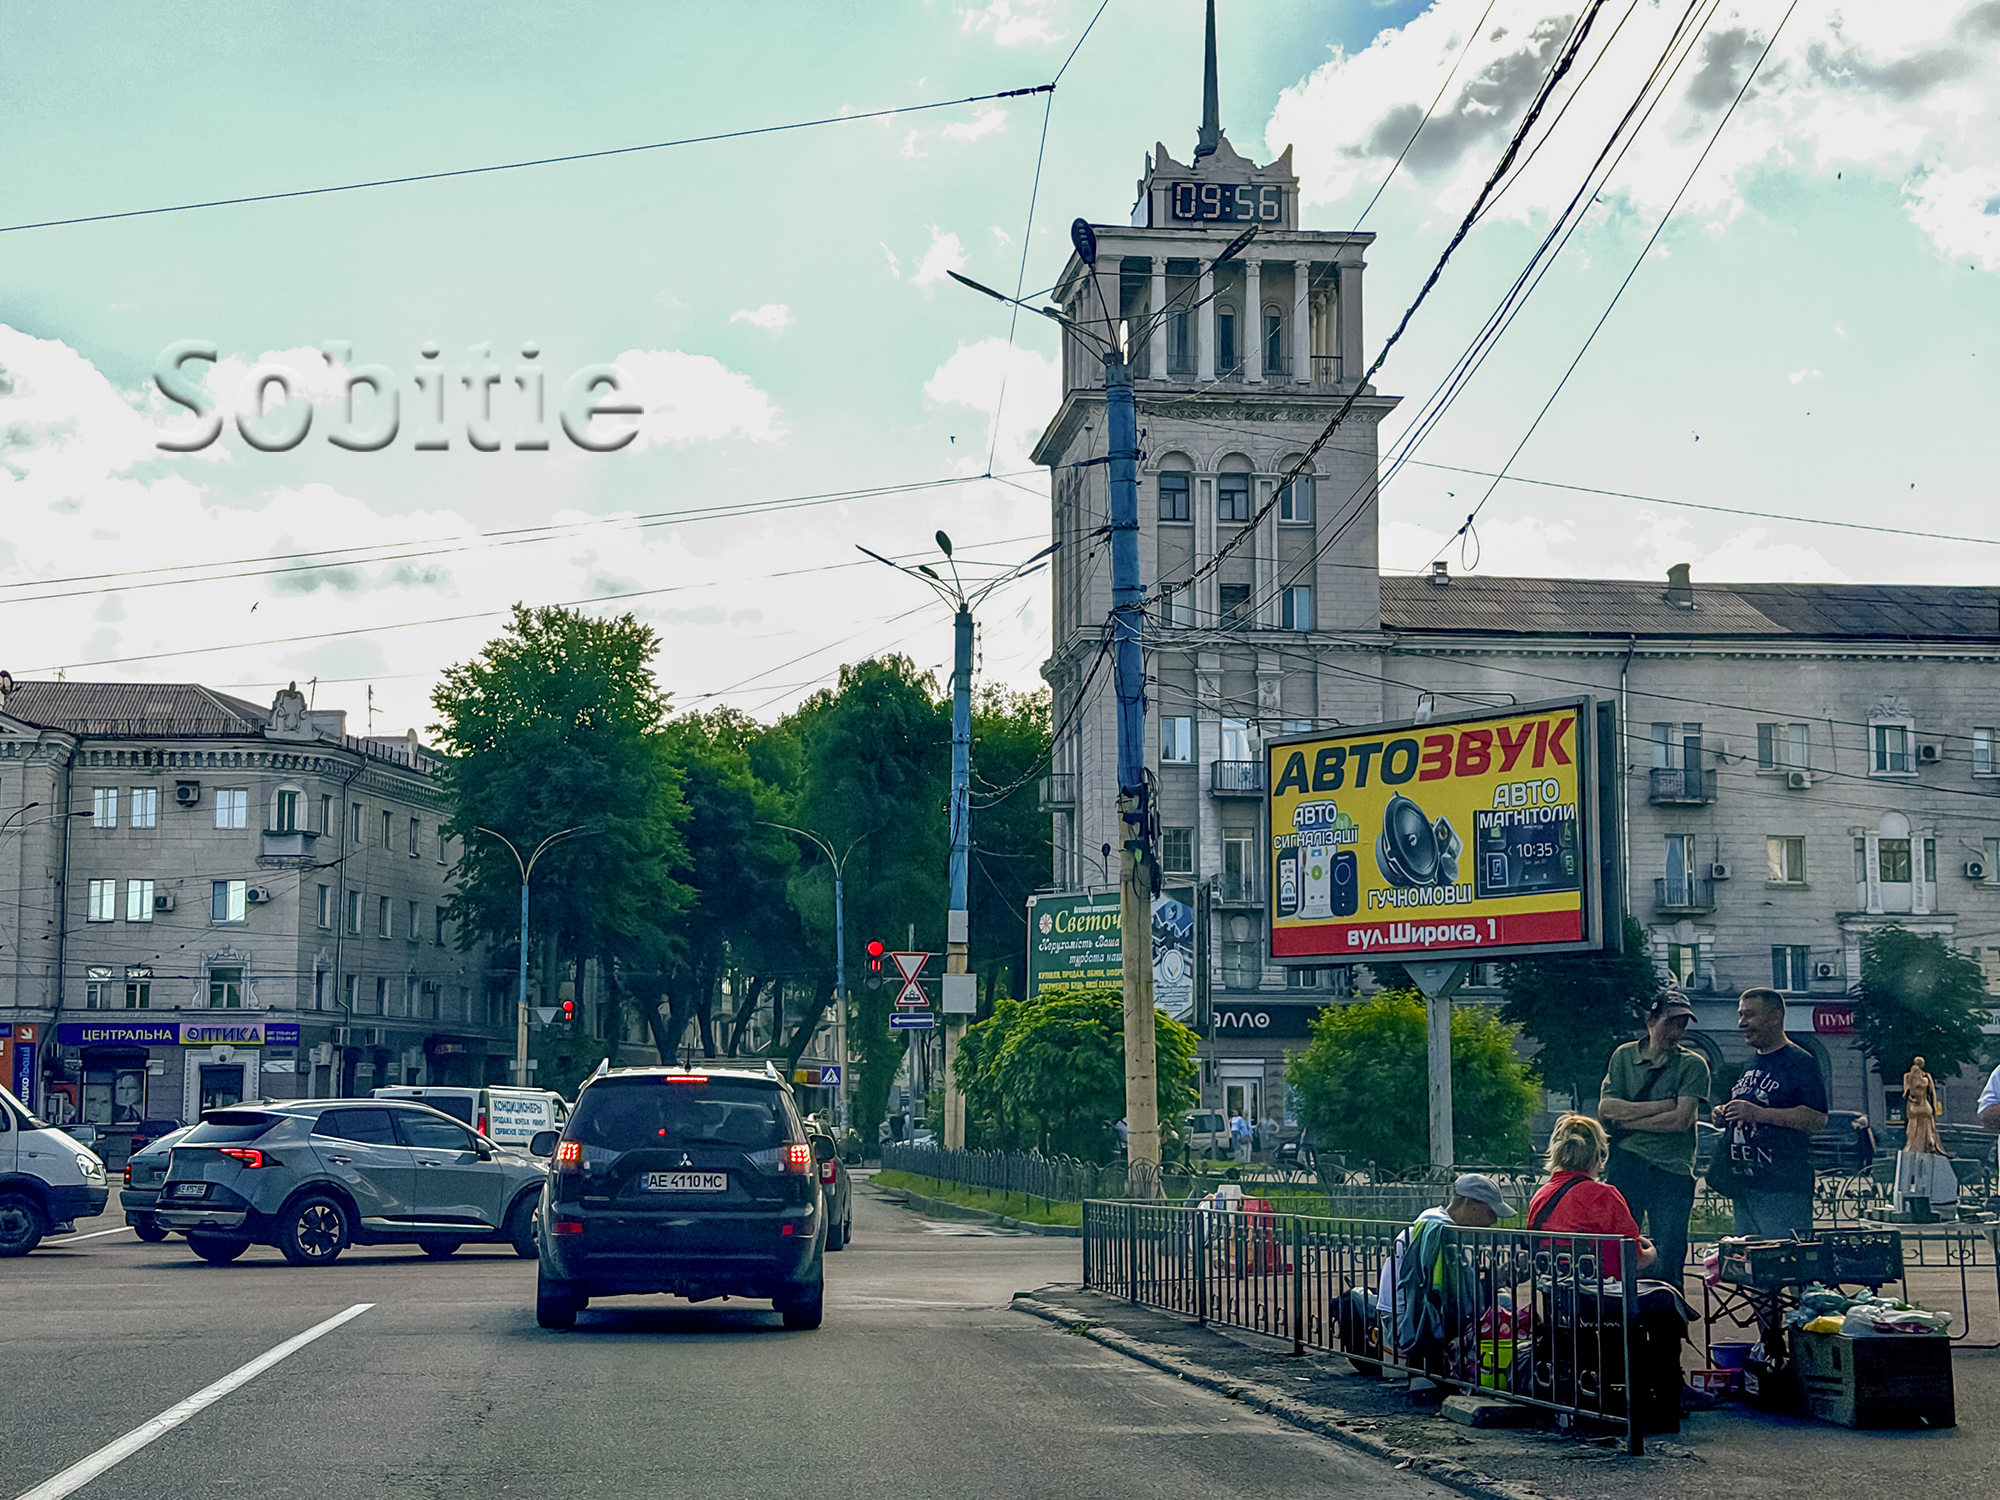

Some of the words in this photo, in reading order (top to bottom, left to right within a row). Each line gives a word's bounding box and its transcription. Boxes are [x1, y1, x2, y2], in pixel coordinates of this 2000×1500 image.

[1176, 183, 1279, 221] 09:56
[1273, 716, 1576, 797] АВТОЗВУК
[1493, 778, 1560, 808] АВТО
[1293, 804, 1338, 826] АВТО
[1479, 803, 1576, 829] МАГНІТОЛИ
[1516, 843, 1553, 857] 10:35
[1368, 884, 1473, 909] ГУЧНОМОВЦІ
[1055, 910, 1122, 934] Светоч
[1347, 922, 1482, 950] вул.Широка,
[1486, 918, 1497, 940] 1
[1095, 935, 1120, 948] Ваша
[1069, 951, 1104, 967] турбота
[1106, 953, 1123, 963] наш
[82, 1029, 173, 1041] ЦЕНТРАЛЬНА
[185, 1027, 262, 1042] ОПТИКА
[649, 1175, 667, 1188] AE
[670, 1175, 700, 1188] 4110
[703, 1175, 723, 1188] MC
